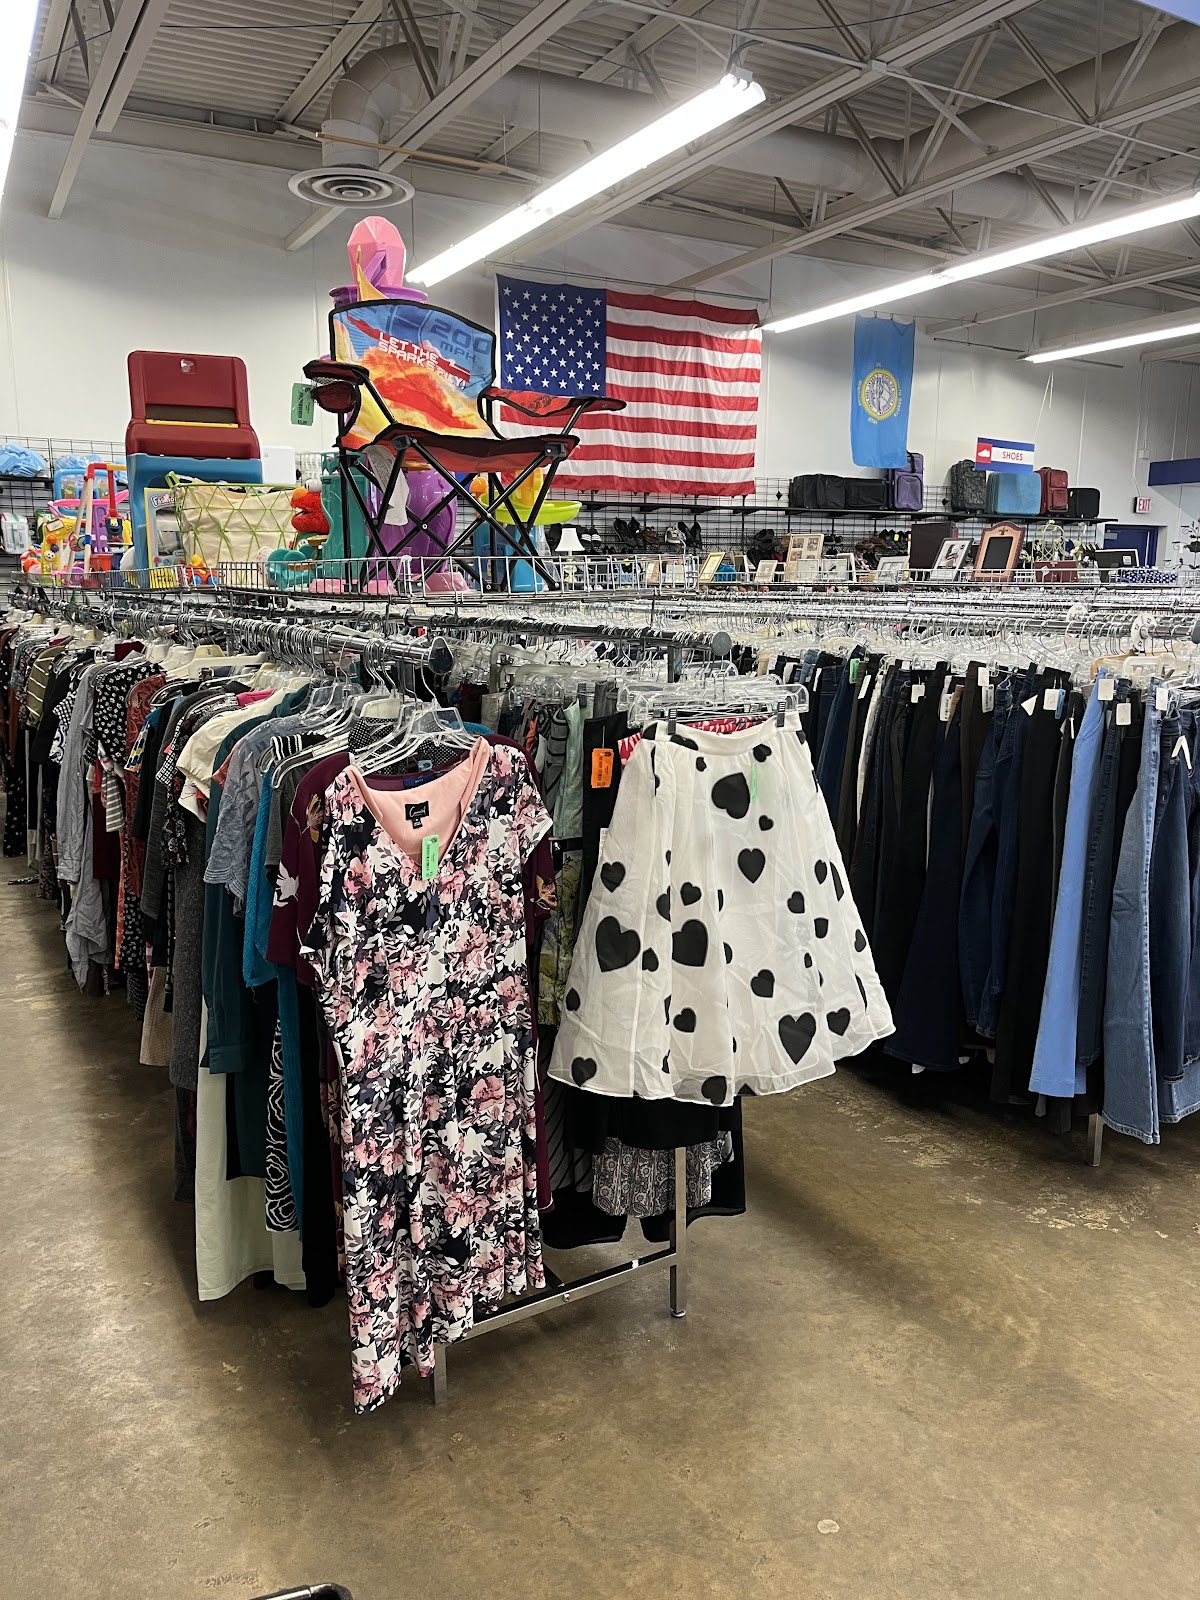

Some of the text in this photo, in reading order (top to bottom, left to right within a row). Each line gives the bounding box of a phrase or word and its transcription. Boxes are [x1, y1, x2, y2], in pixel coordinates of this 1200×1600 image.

[379, 331, 438, 364] LET THE
[430, 318, 492, 354] 200
[378, 341, 435, 372] SPARKS
[440, 342, 476, 364] MPH
[1002, 451, 1024, 461] SHOES
[1138, 498, 1151, 511] EXIT
